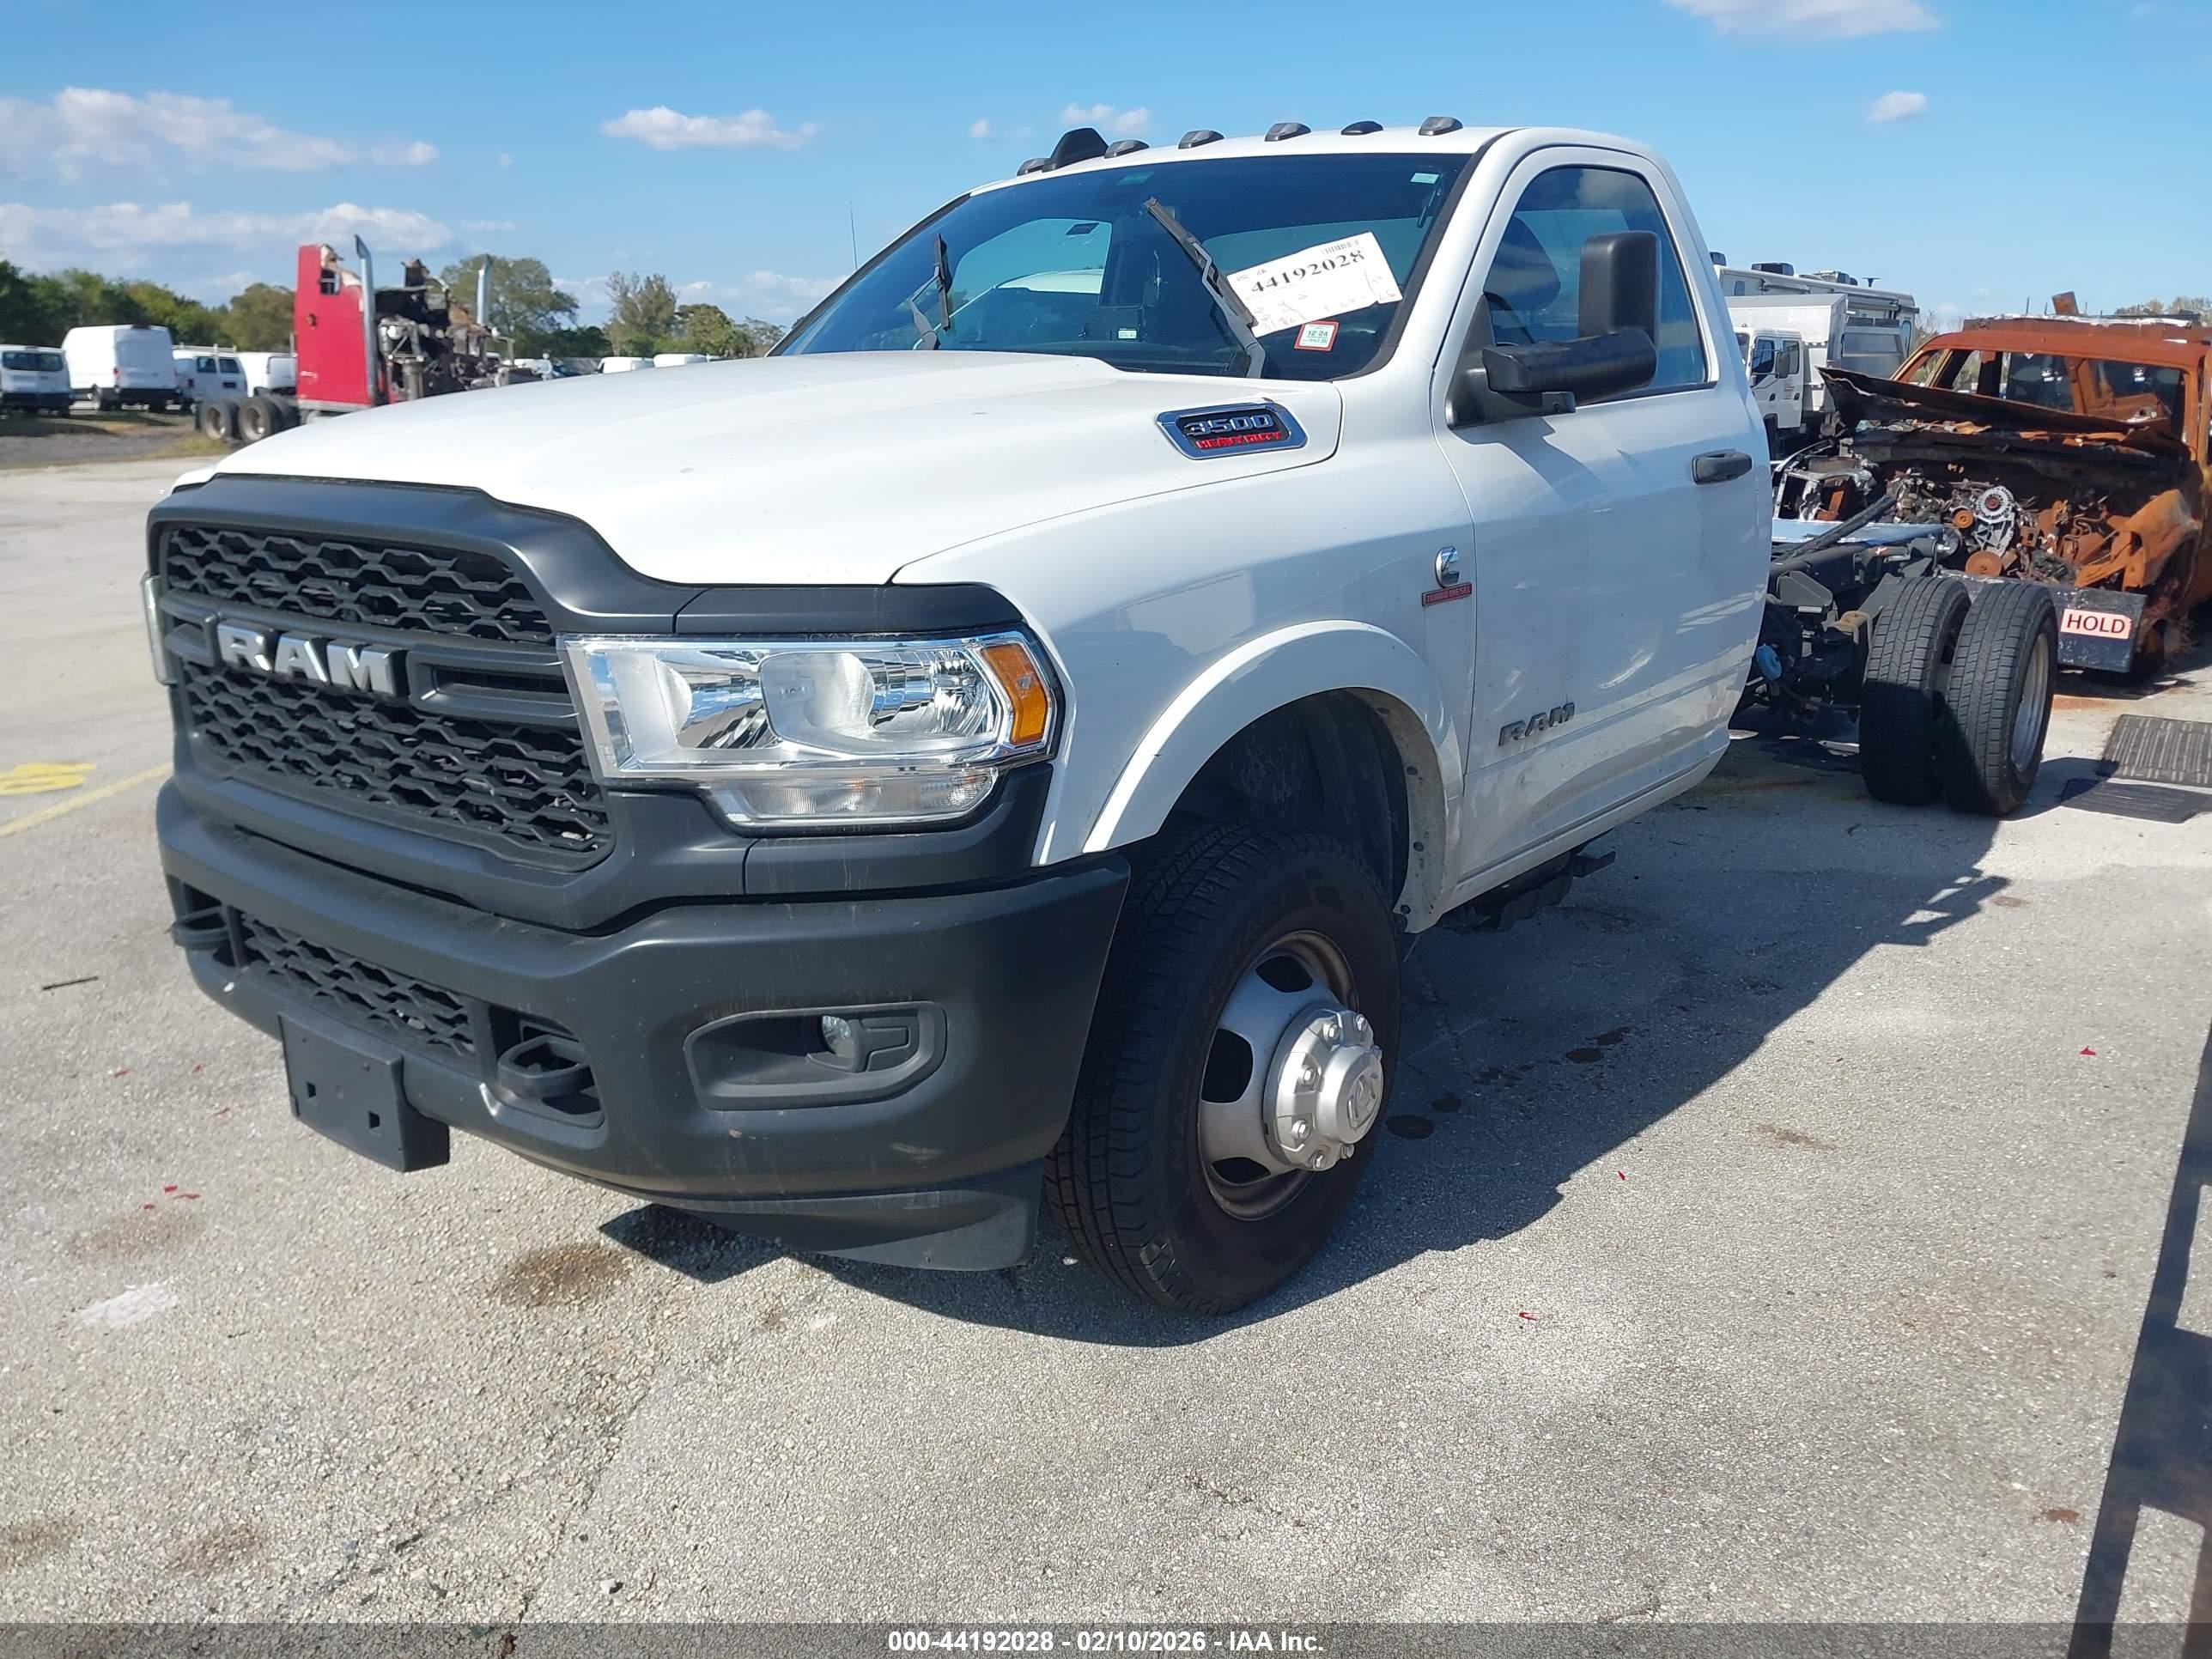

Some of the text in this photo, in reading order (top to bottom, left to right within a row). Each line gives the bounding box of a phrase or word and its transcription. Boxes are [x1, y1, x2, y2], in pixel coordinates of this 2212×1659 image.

[1251, 249, 1365, 293] 44192028
[1184, 413, 1274, 436] 3500
[1426, 586, 1471, 603] TURBO DIESEL
[2067, 613, 2126, 634] HOLD
[217, 620, 400, 696] RAM
[1498, 702, 1576, 746] RAM
